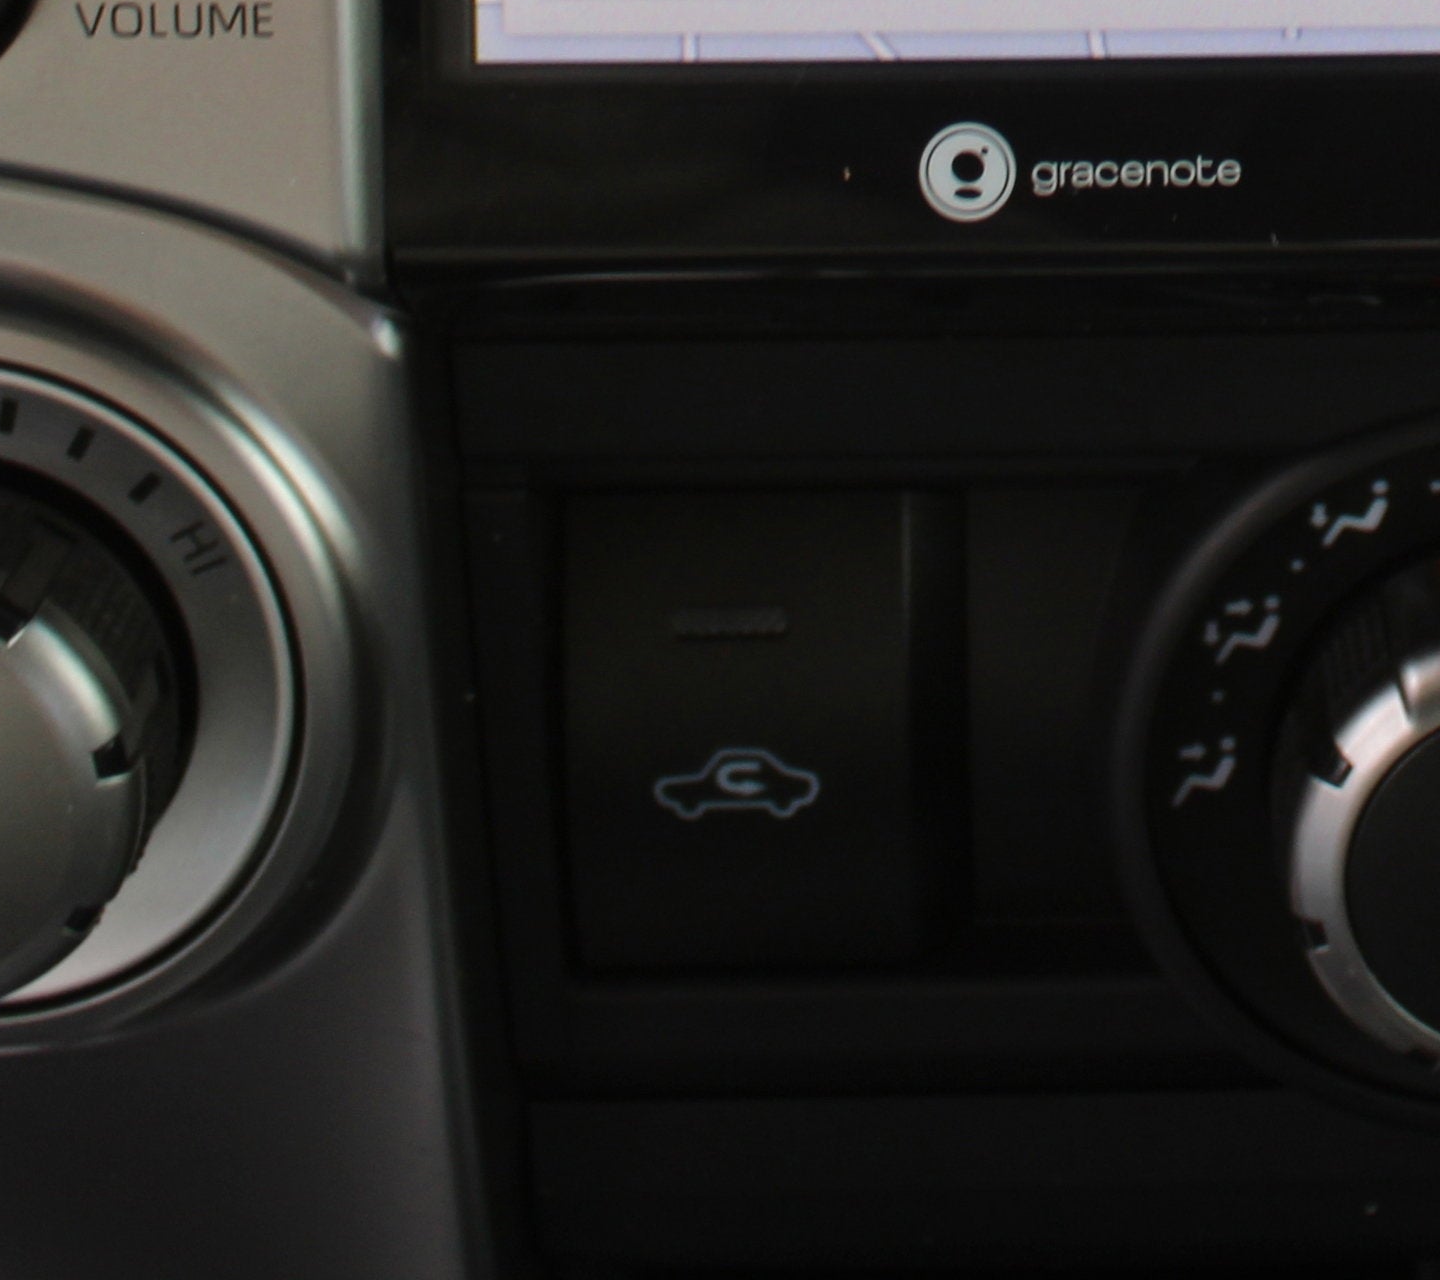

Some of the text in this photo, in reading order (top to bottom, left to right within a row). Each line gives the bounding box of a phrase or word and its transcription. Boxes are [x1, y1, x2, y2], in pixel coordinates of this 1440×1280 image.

[76, 0, 275, 38] VOLUME
[1030, 154, 1243, 197] gracenote
[170, 519, 228, 577] HI
